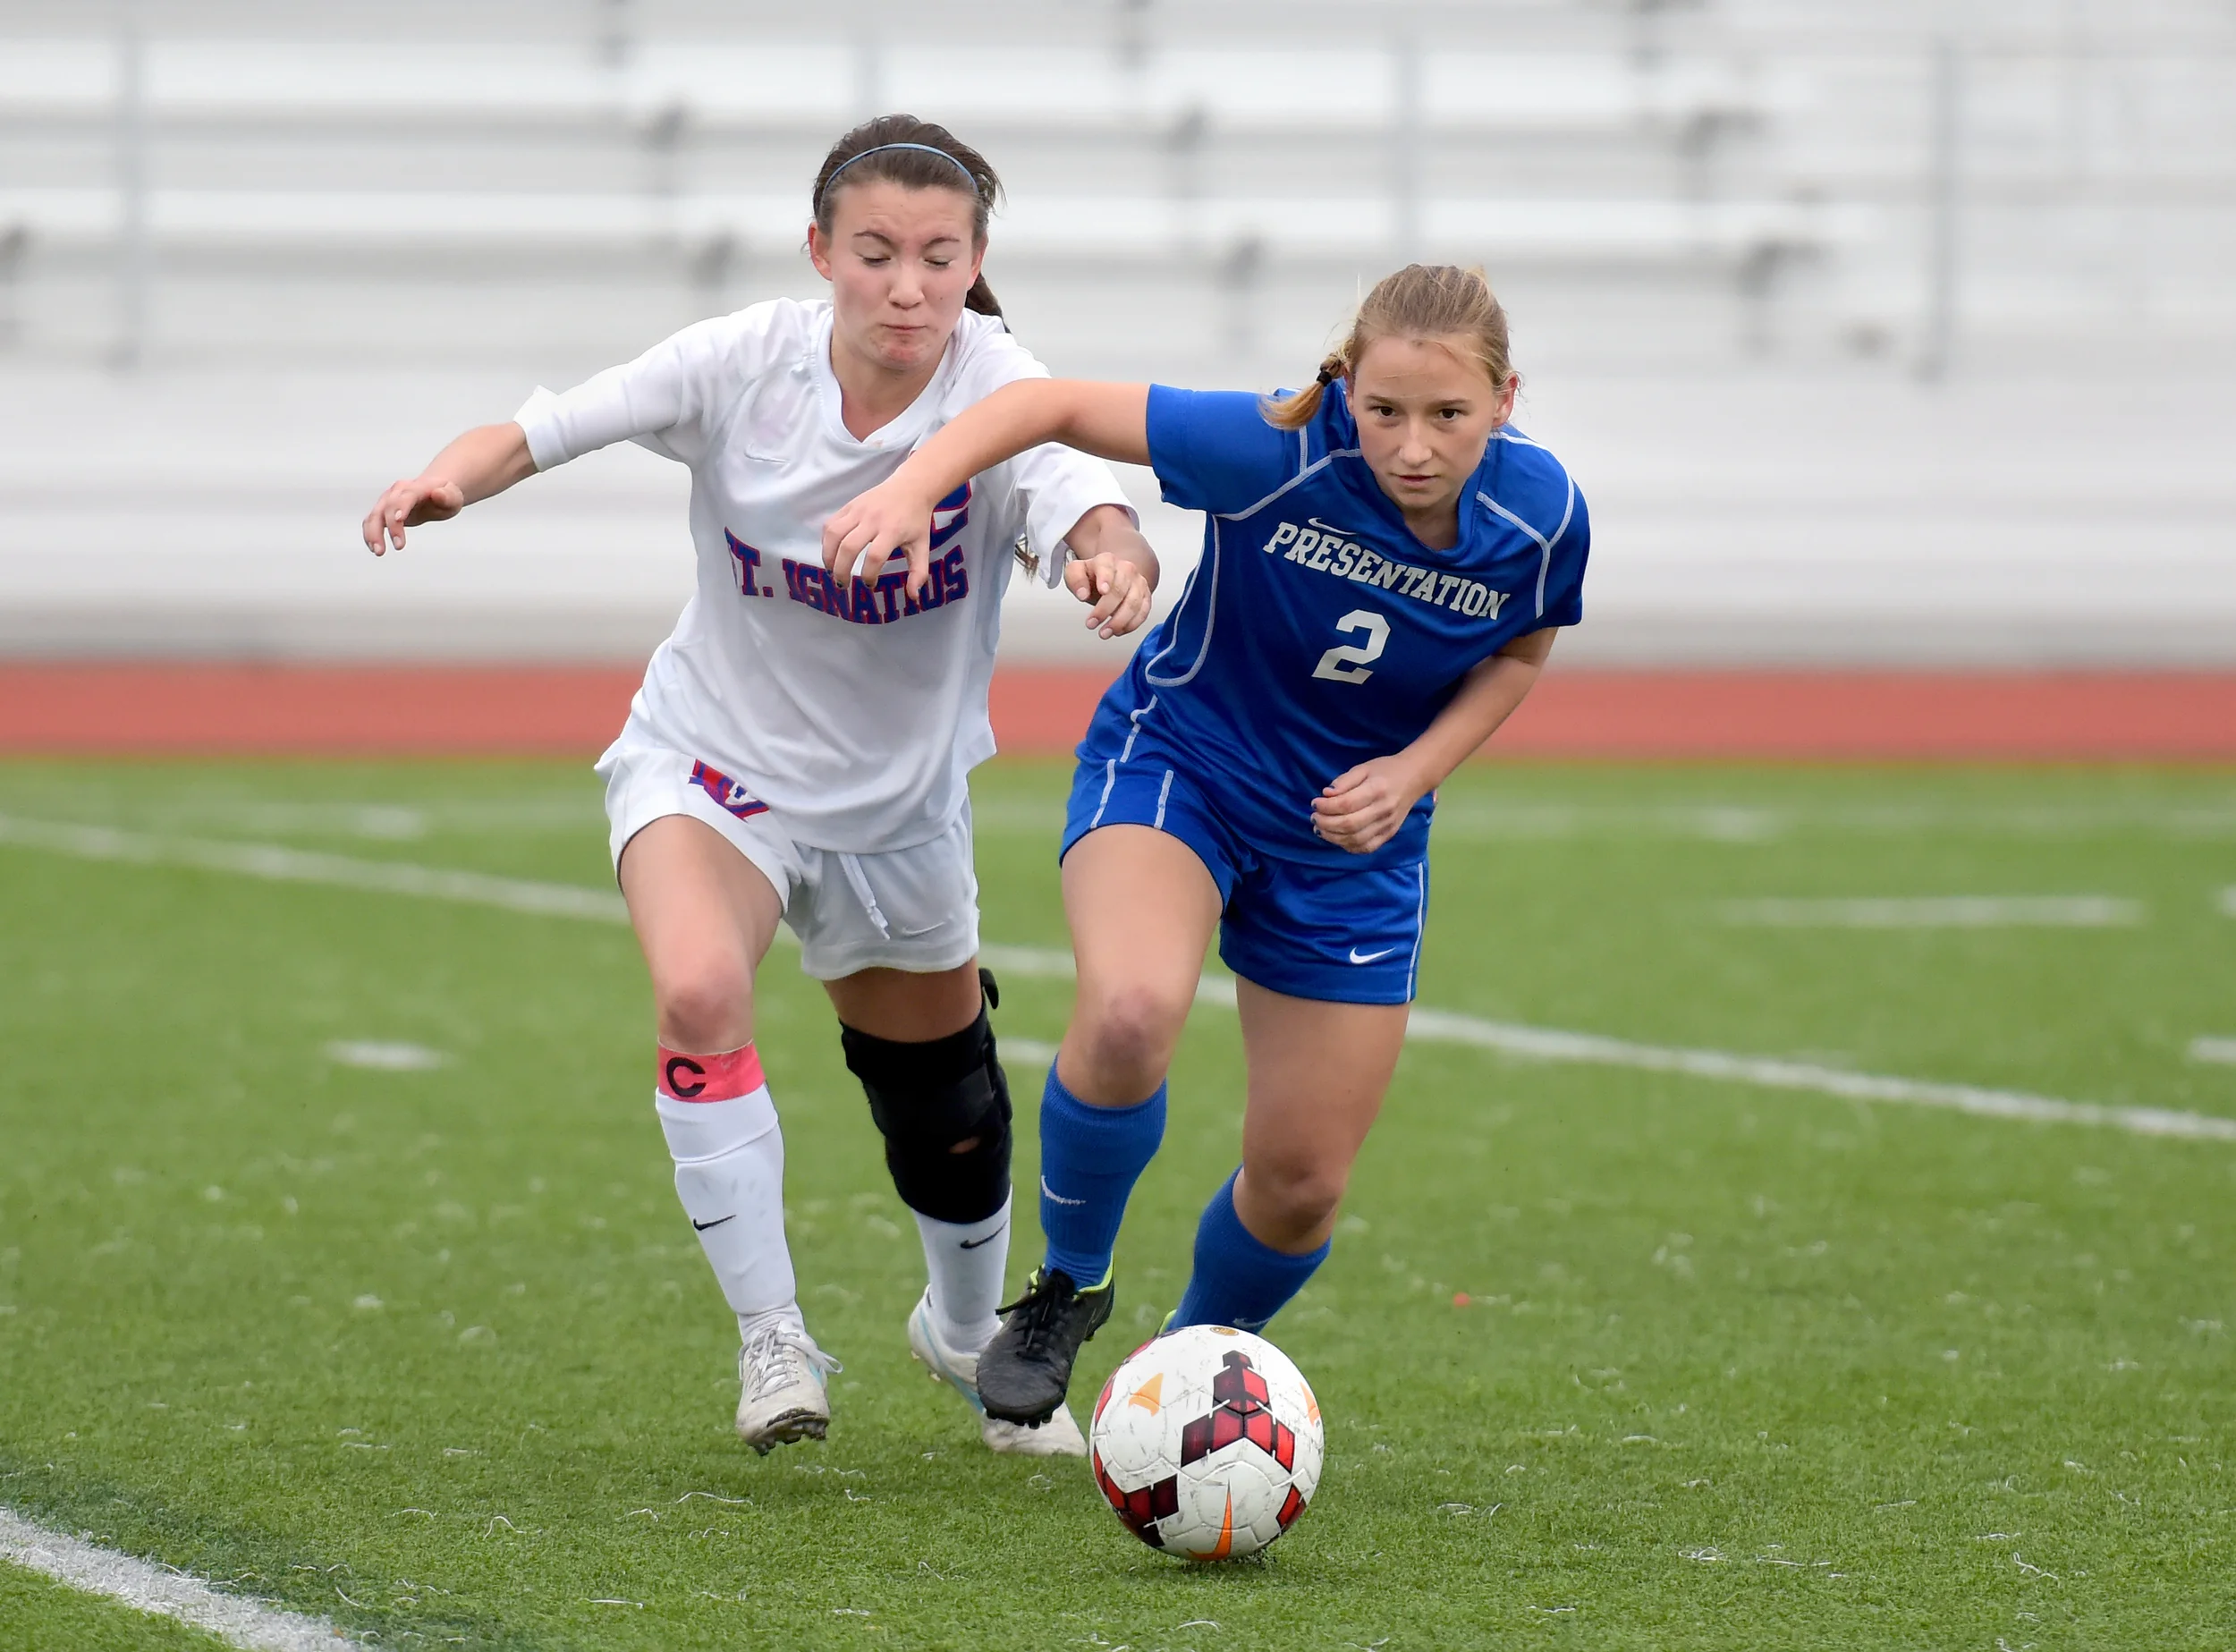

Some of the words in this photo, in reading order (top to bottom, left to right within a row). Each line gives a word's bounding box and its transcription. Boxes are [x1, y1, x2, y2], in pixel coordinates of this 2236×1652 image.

[724, 526, 775, 598] T.
[1262, 521, 1511, 621] PRESENTATION
[1311, 609, 1391, 685] 2
[666, 1056, 707, 1097] C
